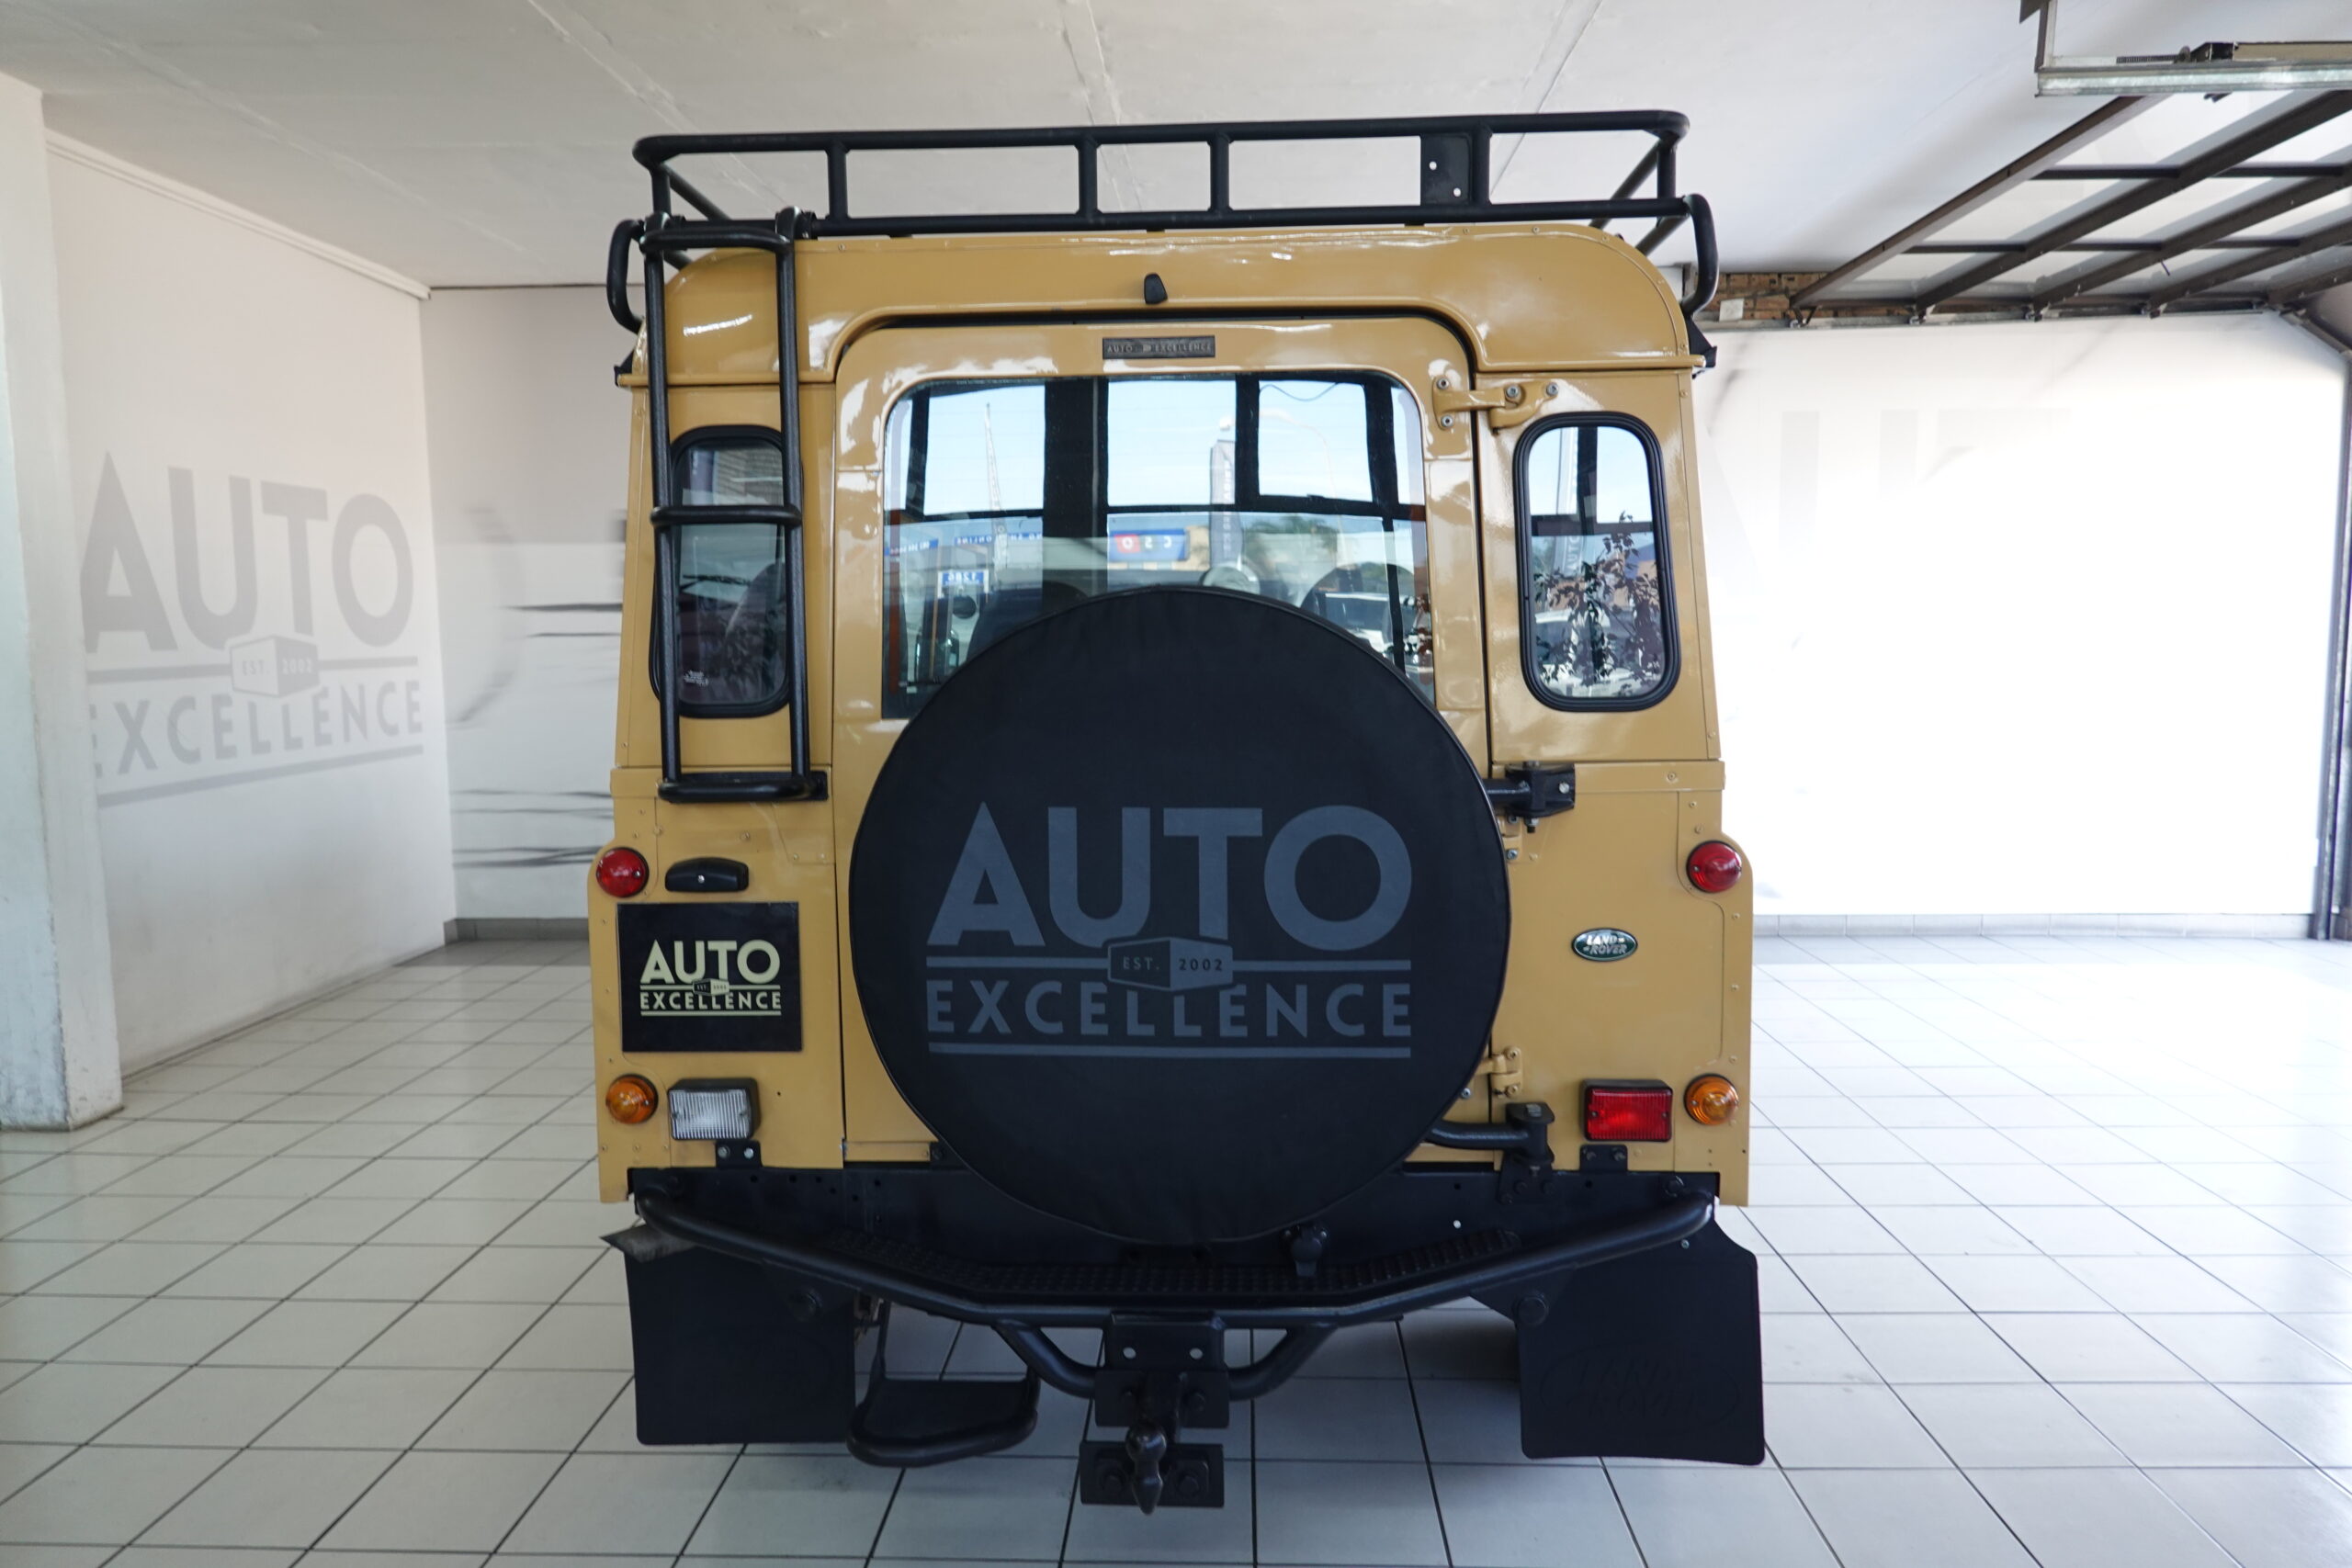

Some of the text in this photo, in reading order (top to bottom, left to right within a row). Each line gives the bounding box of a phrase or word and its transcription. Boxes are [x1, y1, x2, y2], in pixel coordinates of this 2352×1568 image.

[80, 450, 414, 654] AUTO
[926, 801, 1412, 952] AUTO
[1587, 935, 1618, 945] LAND
[1589, 944, 1628, 954] ROVER
[639, 939, 781, 985] AUTO
[1123, 956, 1223, 971] EST. 2002
[639, 991, 782, 1010] EXCELLENCE
[926, 979, 1412, 1038] EXCELLENCE
